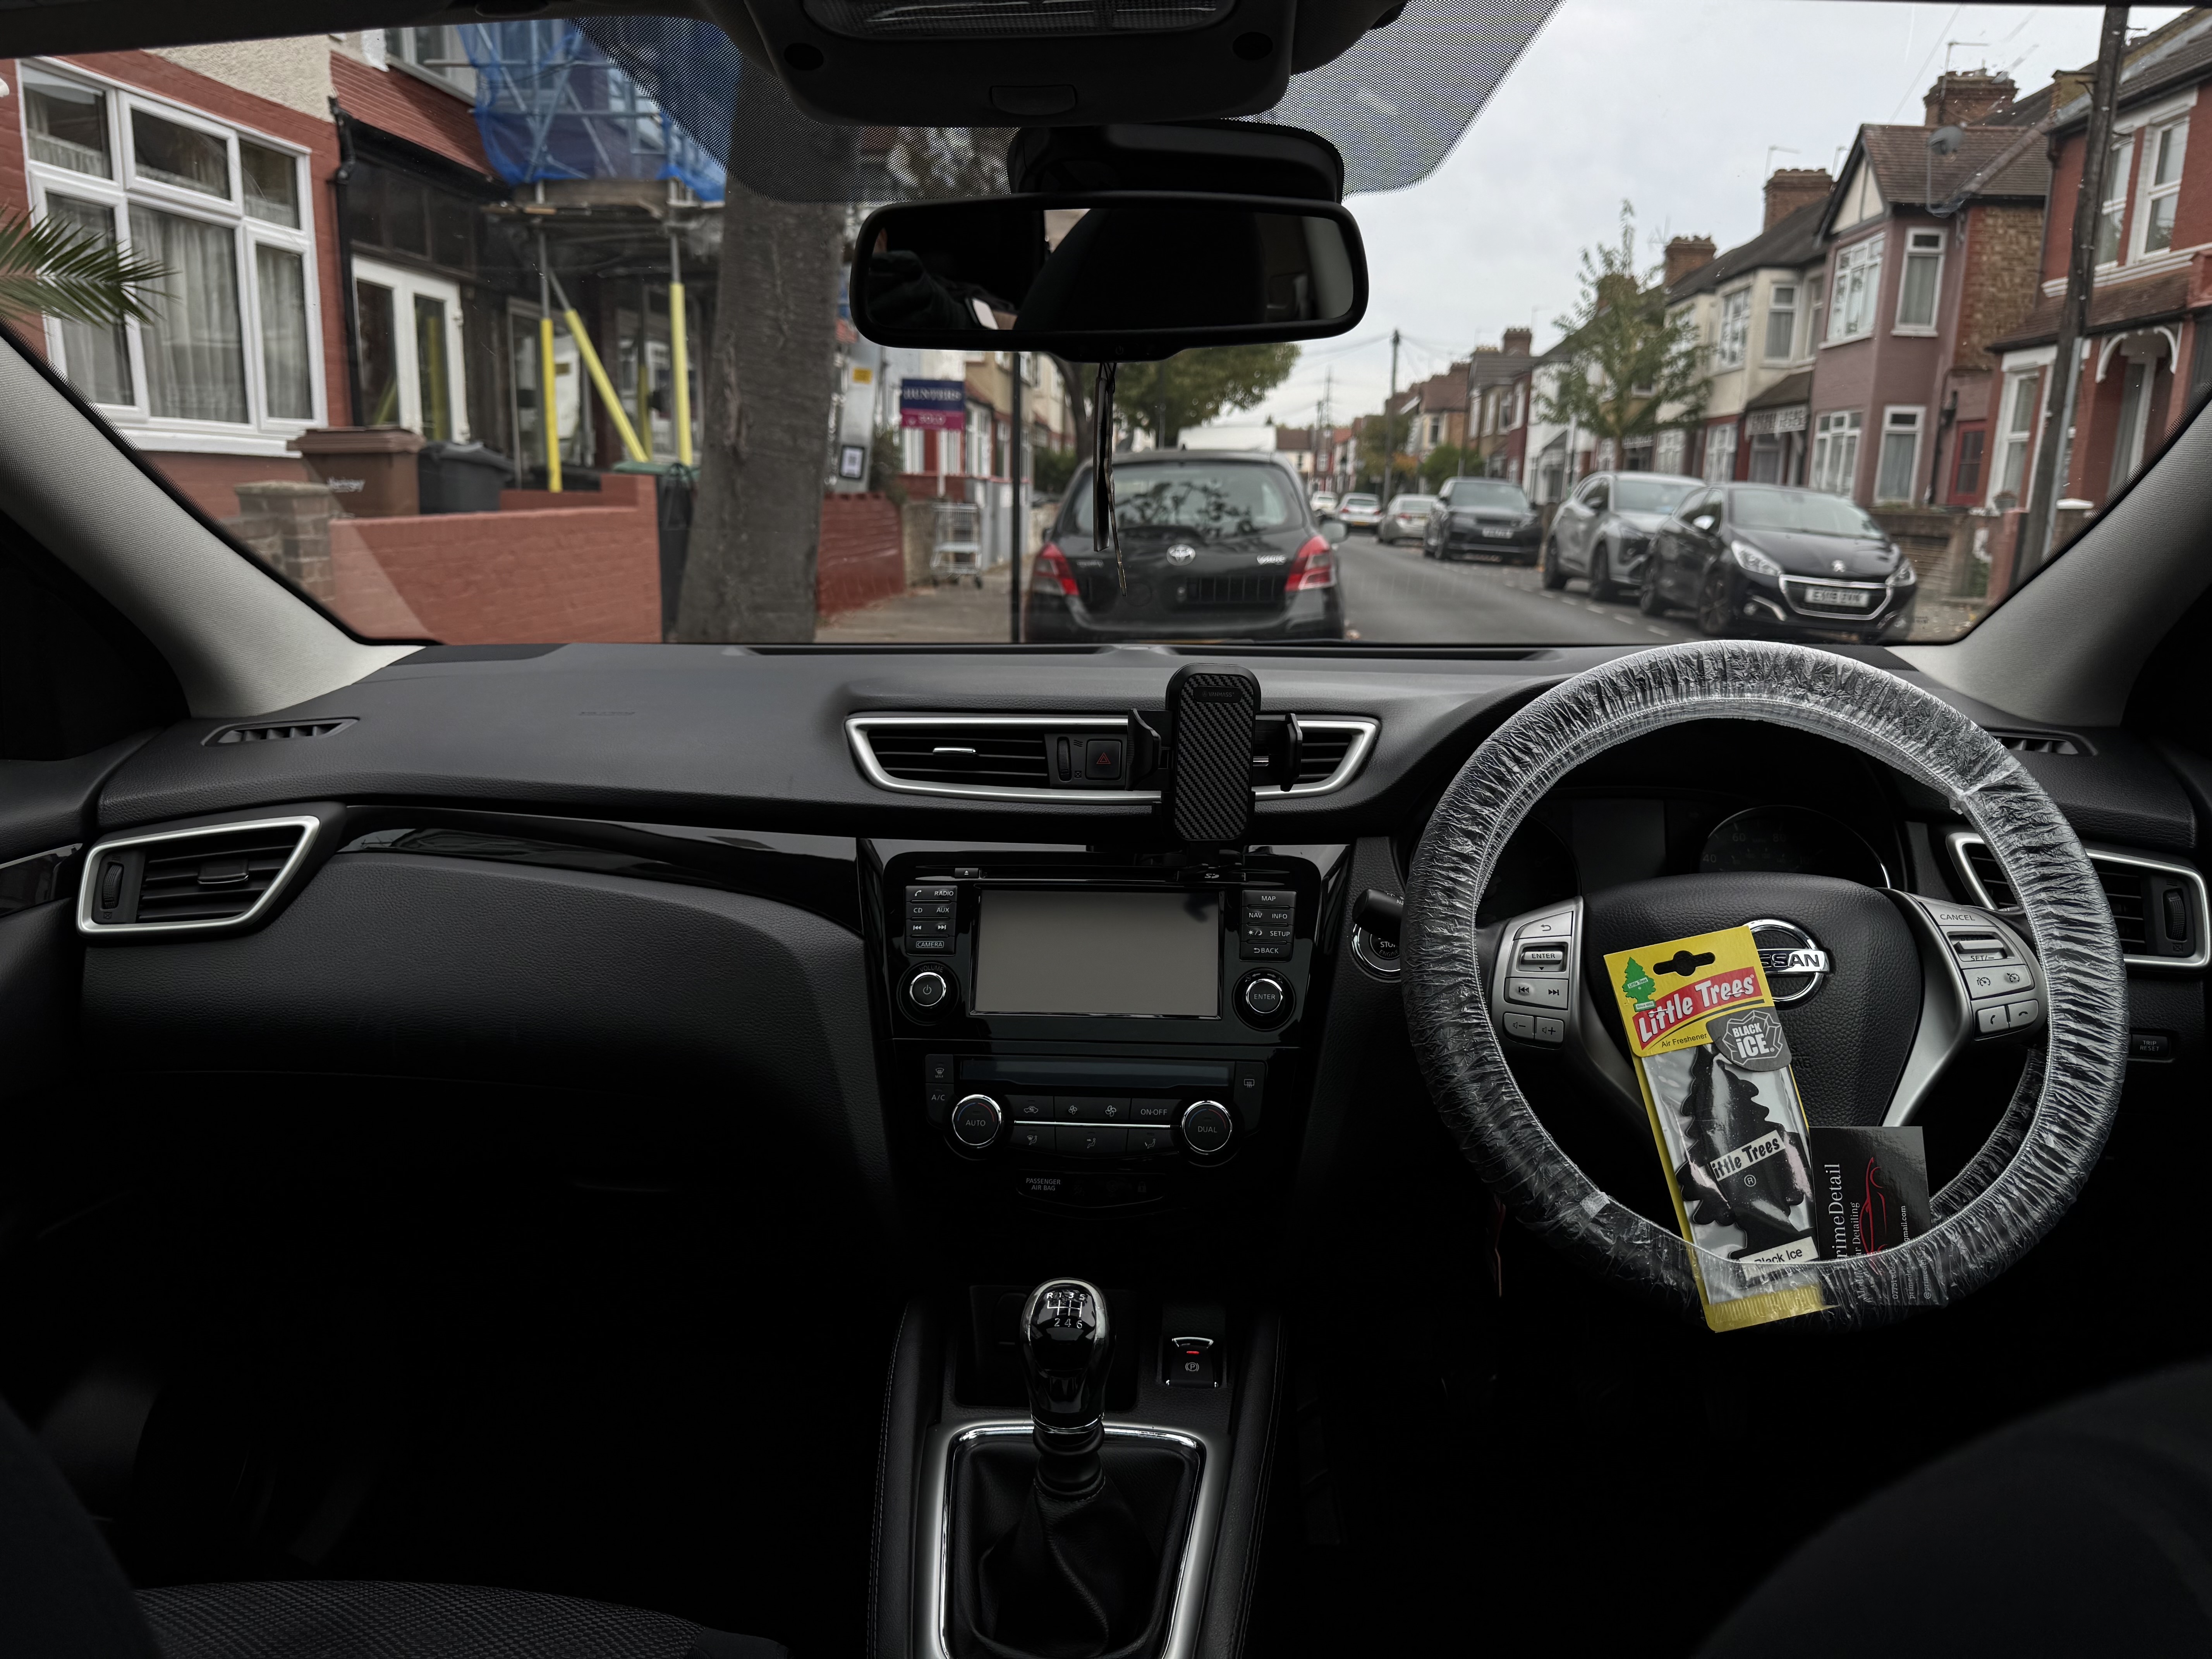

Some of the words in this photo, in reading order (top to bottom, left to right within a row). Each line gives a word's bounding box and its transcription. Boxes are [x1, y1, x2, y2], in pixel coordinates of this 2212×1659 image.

[1703, 854, 1717, 863] 40
[1759, 953, 1820, 968] SSAN
[919, 964, 944, 972] VOLUME
[1638, 993, 1693, 1043] Little
[1695, 977, 1754, 1007] Trees
[1732, 1023, 1762, 1037] BLACK
[1672, 1033, 1707, 1045] Freshener
[965, 1119, 986, 1127] AUTO
[1198, 1125, 1218, 1133] DUAL
[1712, 1155, 1742, 1179] ittle
[1742, 1138, 1780, 1163] Trees
[1824, 1163, 1848, 1259] rimeDetail
[1850, 1202, 1861, 1245] Detailing
[1786, 1249, 1803, 1260] Ice
[1054, 1318, 1060, 1327] 2
[1064, 1318, 1071, 1327] 4
[1076, 1320, 1082, 1329] 6
